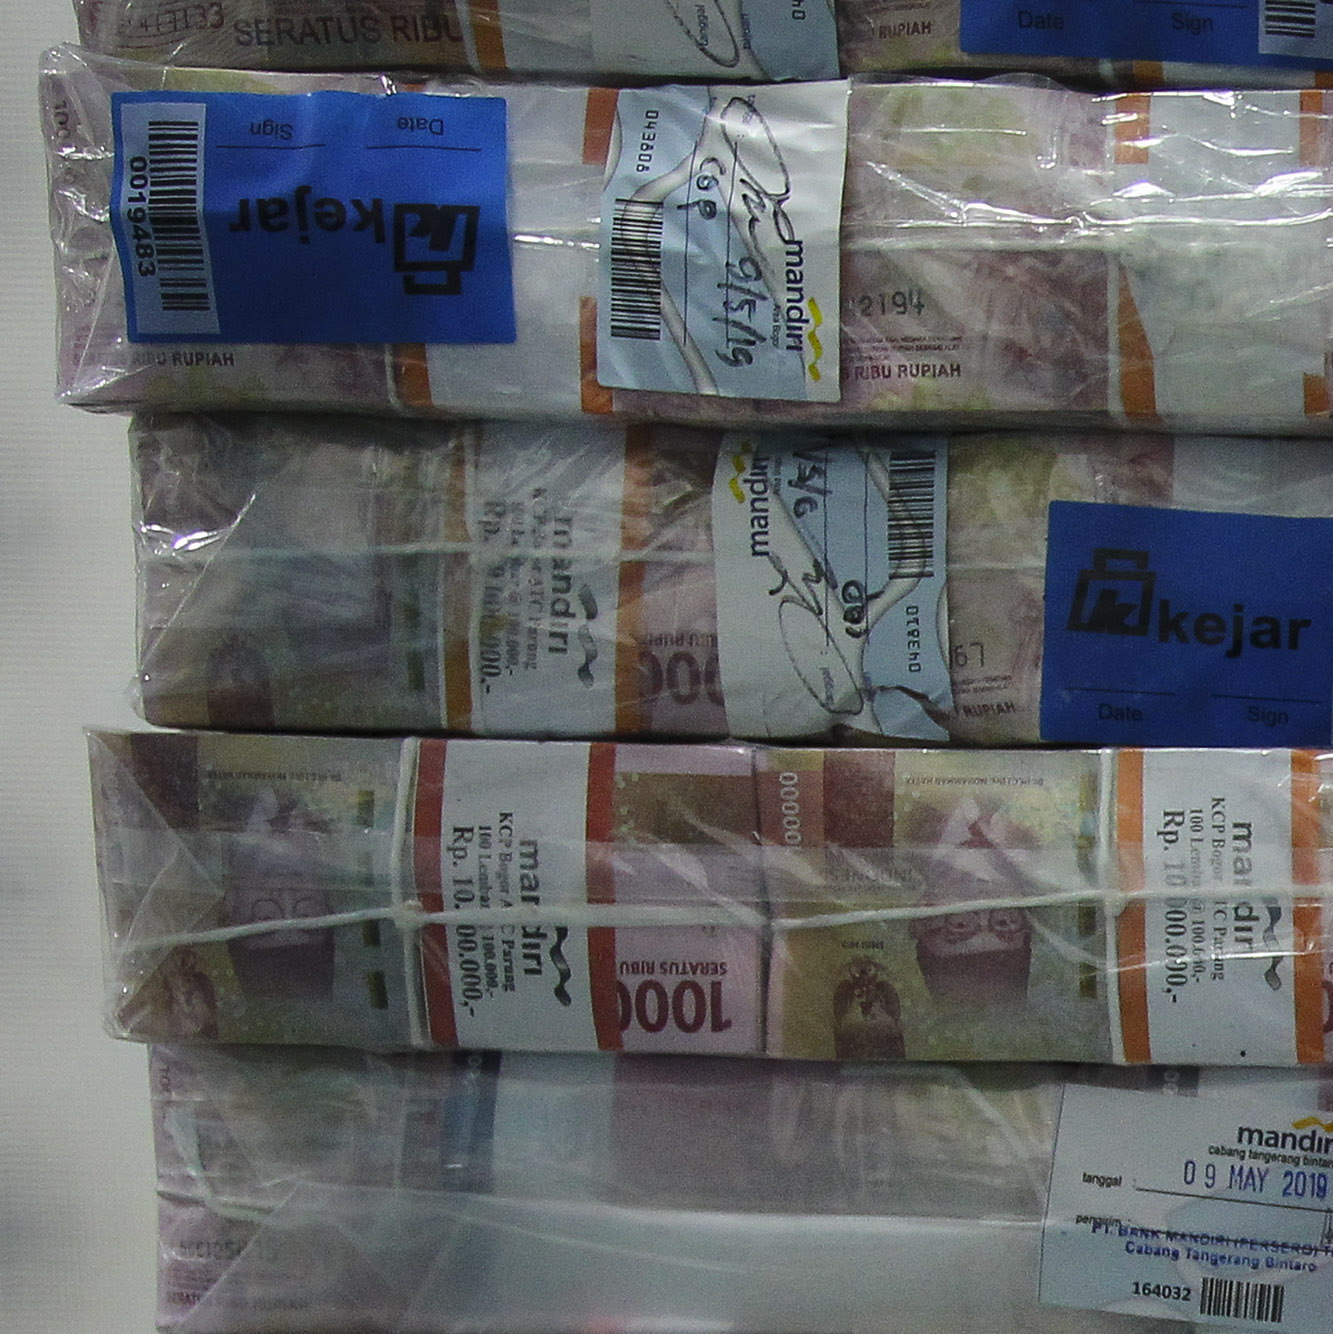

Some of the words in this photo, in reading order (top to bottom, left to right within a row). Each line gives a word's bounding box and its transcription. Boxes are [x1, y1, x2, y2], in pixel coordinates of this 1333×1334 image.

[232, 15, 382, 47] SERATUS
[1017, 11, 1063, 30] Date
[1171, 11, 1214, 33] Sign
[250, 119, 293, 141] Sign
[397, 116, 444, 137] Date
[128, 156, 156, 278] 0019483
[228, 186, 386, 246] kejar
[781, 240, 804, 355] mandiri
[896, 361, 962, 380] RUPIAH
[1159, 600, 1312, 660] kejar
[1099, 703, 1144, 724] Date
[1247, 706, 1290, 728] Sign
[1158, 809, 1186, 852] Rp.
[1188, 807, 1205, 833] 100
[1209, 796, 1225, 833] KCP
[447, 825, 476, 867] Rp.
[1208, 1144, 1246, 1161] cabang
[1248, 1149, 1300, 1167] tangerang
[1081, 1171, 1123, 1188] tanggal
[1229, 1164, 1270, 1193] MAY
[1282, 1171, 1329, 1199] 2019
[1124, 1241, 1180, 1262] Cabang
[1185, 1246, 1260, 1269] Tangerang
[1264, 1256, 1319, 1274] Bintaro
[1132, 1281, 1192, 1302] 164032
